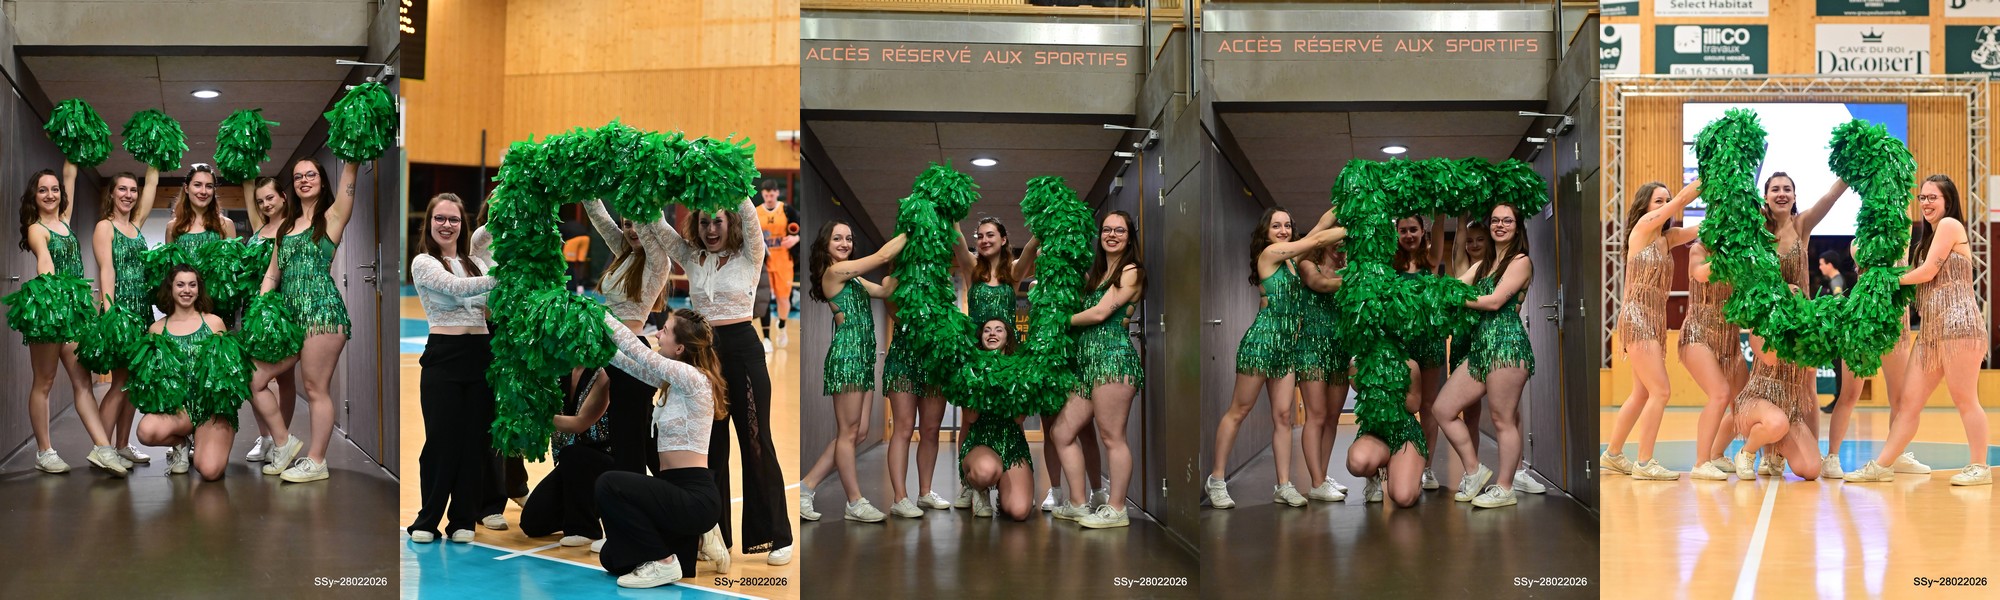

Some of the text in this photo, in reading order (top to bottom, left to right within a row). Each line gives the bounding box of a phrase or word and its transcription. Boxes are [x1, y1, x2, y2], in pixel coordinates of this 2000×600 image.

[1670, 0, 1752, 8] Select Habitat
[1218, 35, 1538, 53] ACCÈS RÉSERVÉ AUX SPORTIFS
[1703, 45, 1740, 53] travaux
[1839, 46, 1905, 54] CAVE DU ROI
[805, 45, 1128, 67] ACCÈS RÉSERVÉ AUX SPORTIFS
[1674, 67, 1749, 75] 06 16 75 16 04
